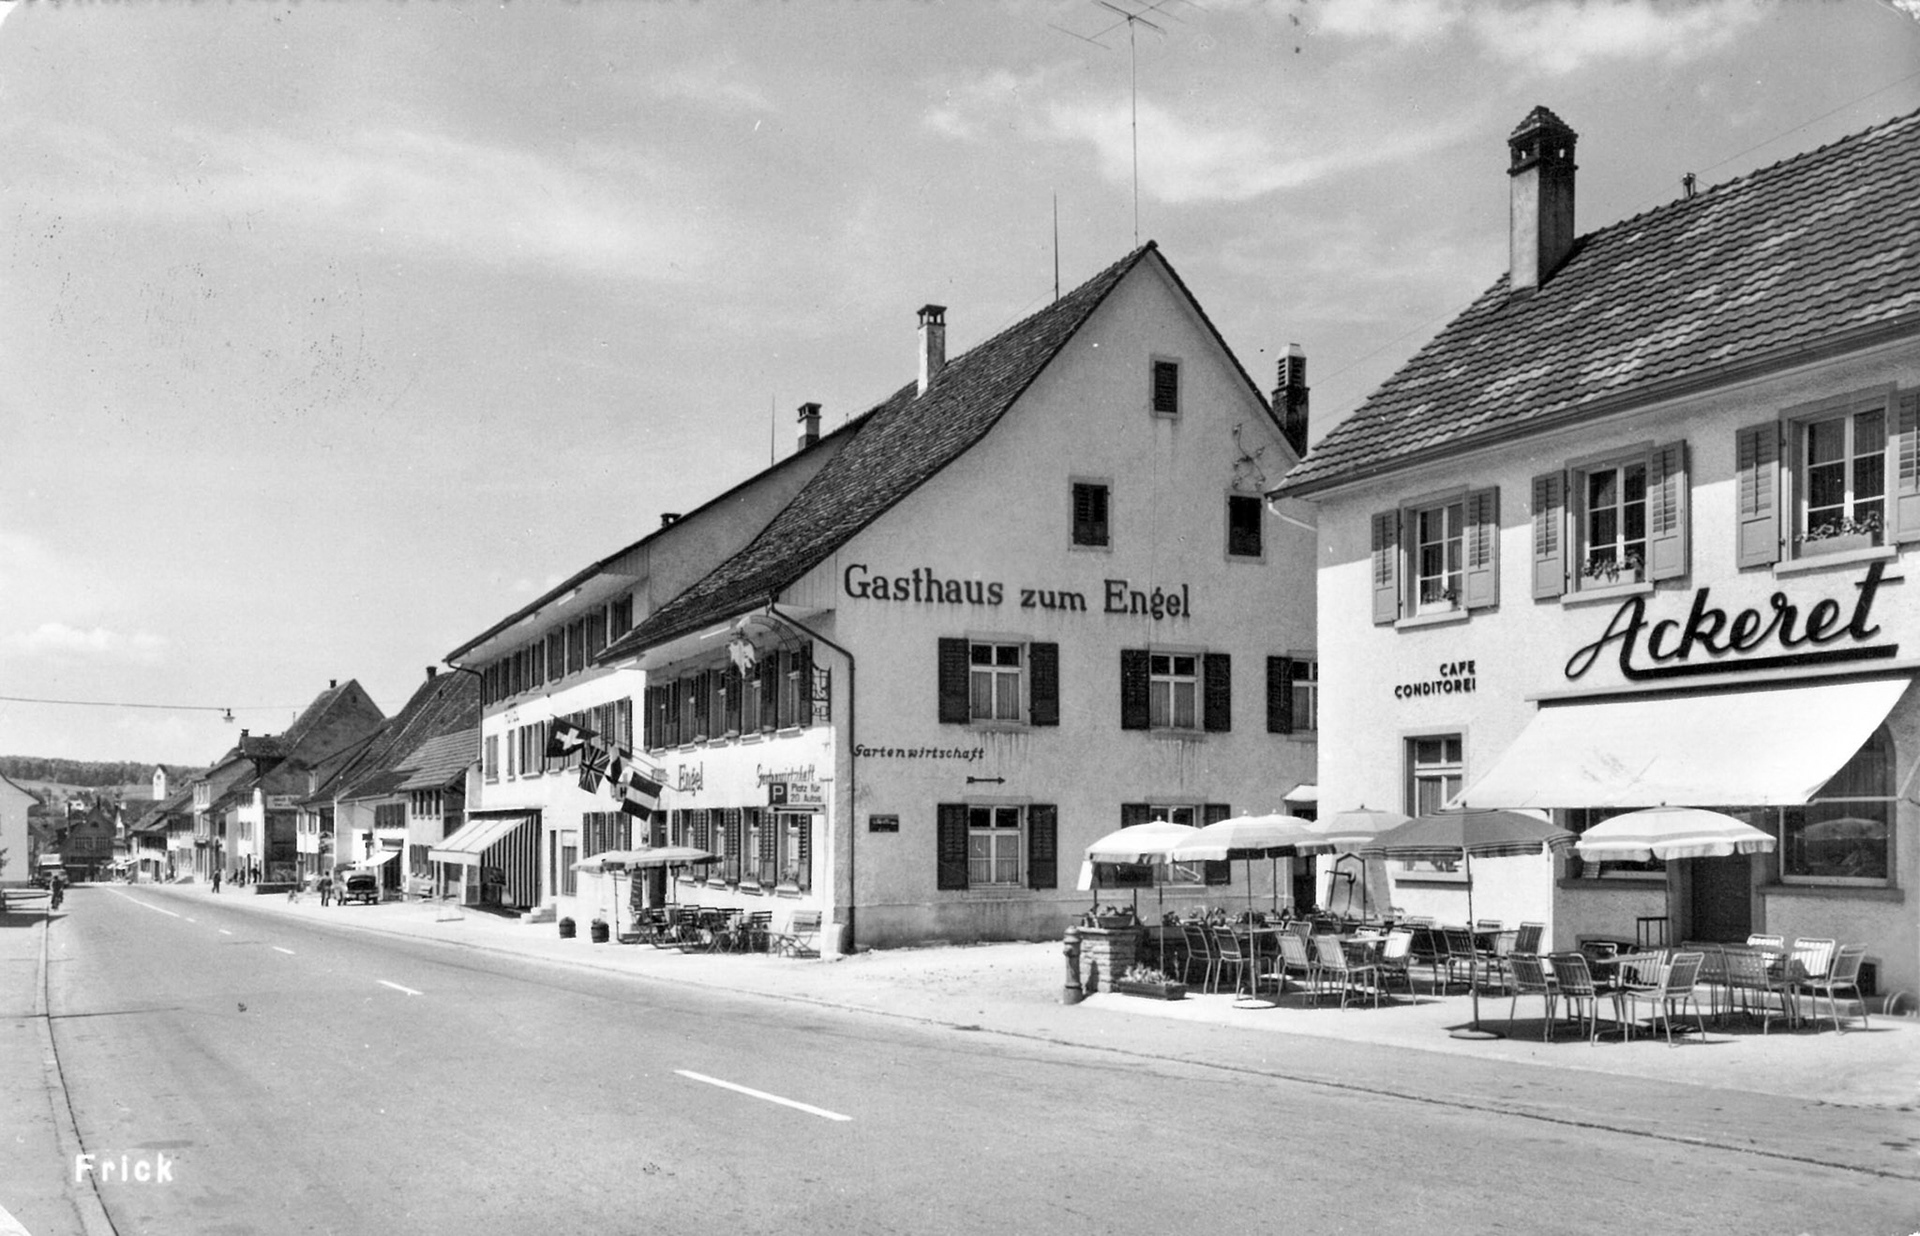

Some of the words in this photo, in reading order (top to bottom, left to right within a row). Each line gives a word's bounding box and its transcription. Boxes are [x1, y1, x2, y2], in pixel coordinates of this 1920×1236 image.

[844, 563, 1004, 605] Gasthaus
[1020, 588, 1087, 612] zum
[1103, 578, 1190, 621] Engel
[1564, 561, 1905, 681] Ackeret
[1440, 660, 1475, 677] CAFE
[1395, 678, 1475, 700] CONDITOREI
[853, 743, 985, 763] Gartenwirtschaft
[678, 761, 703, 797] Engel
[773, 785, 784, 801] P
[790, 794, 800, 802] 20
